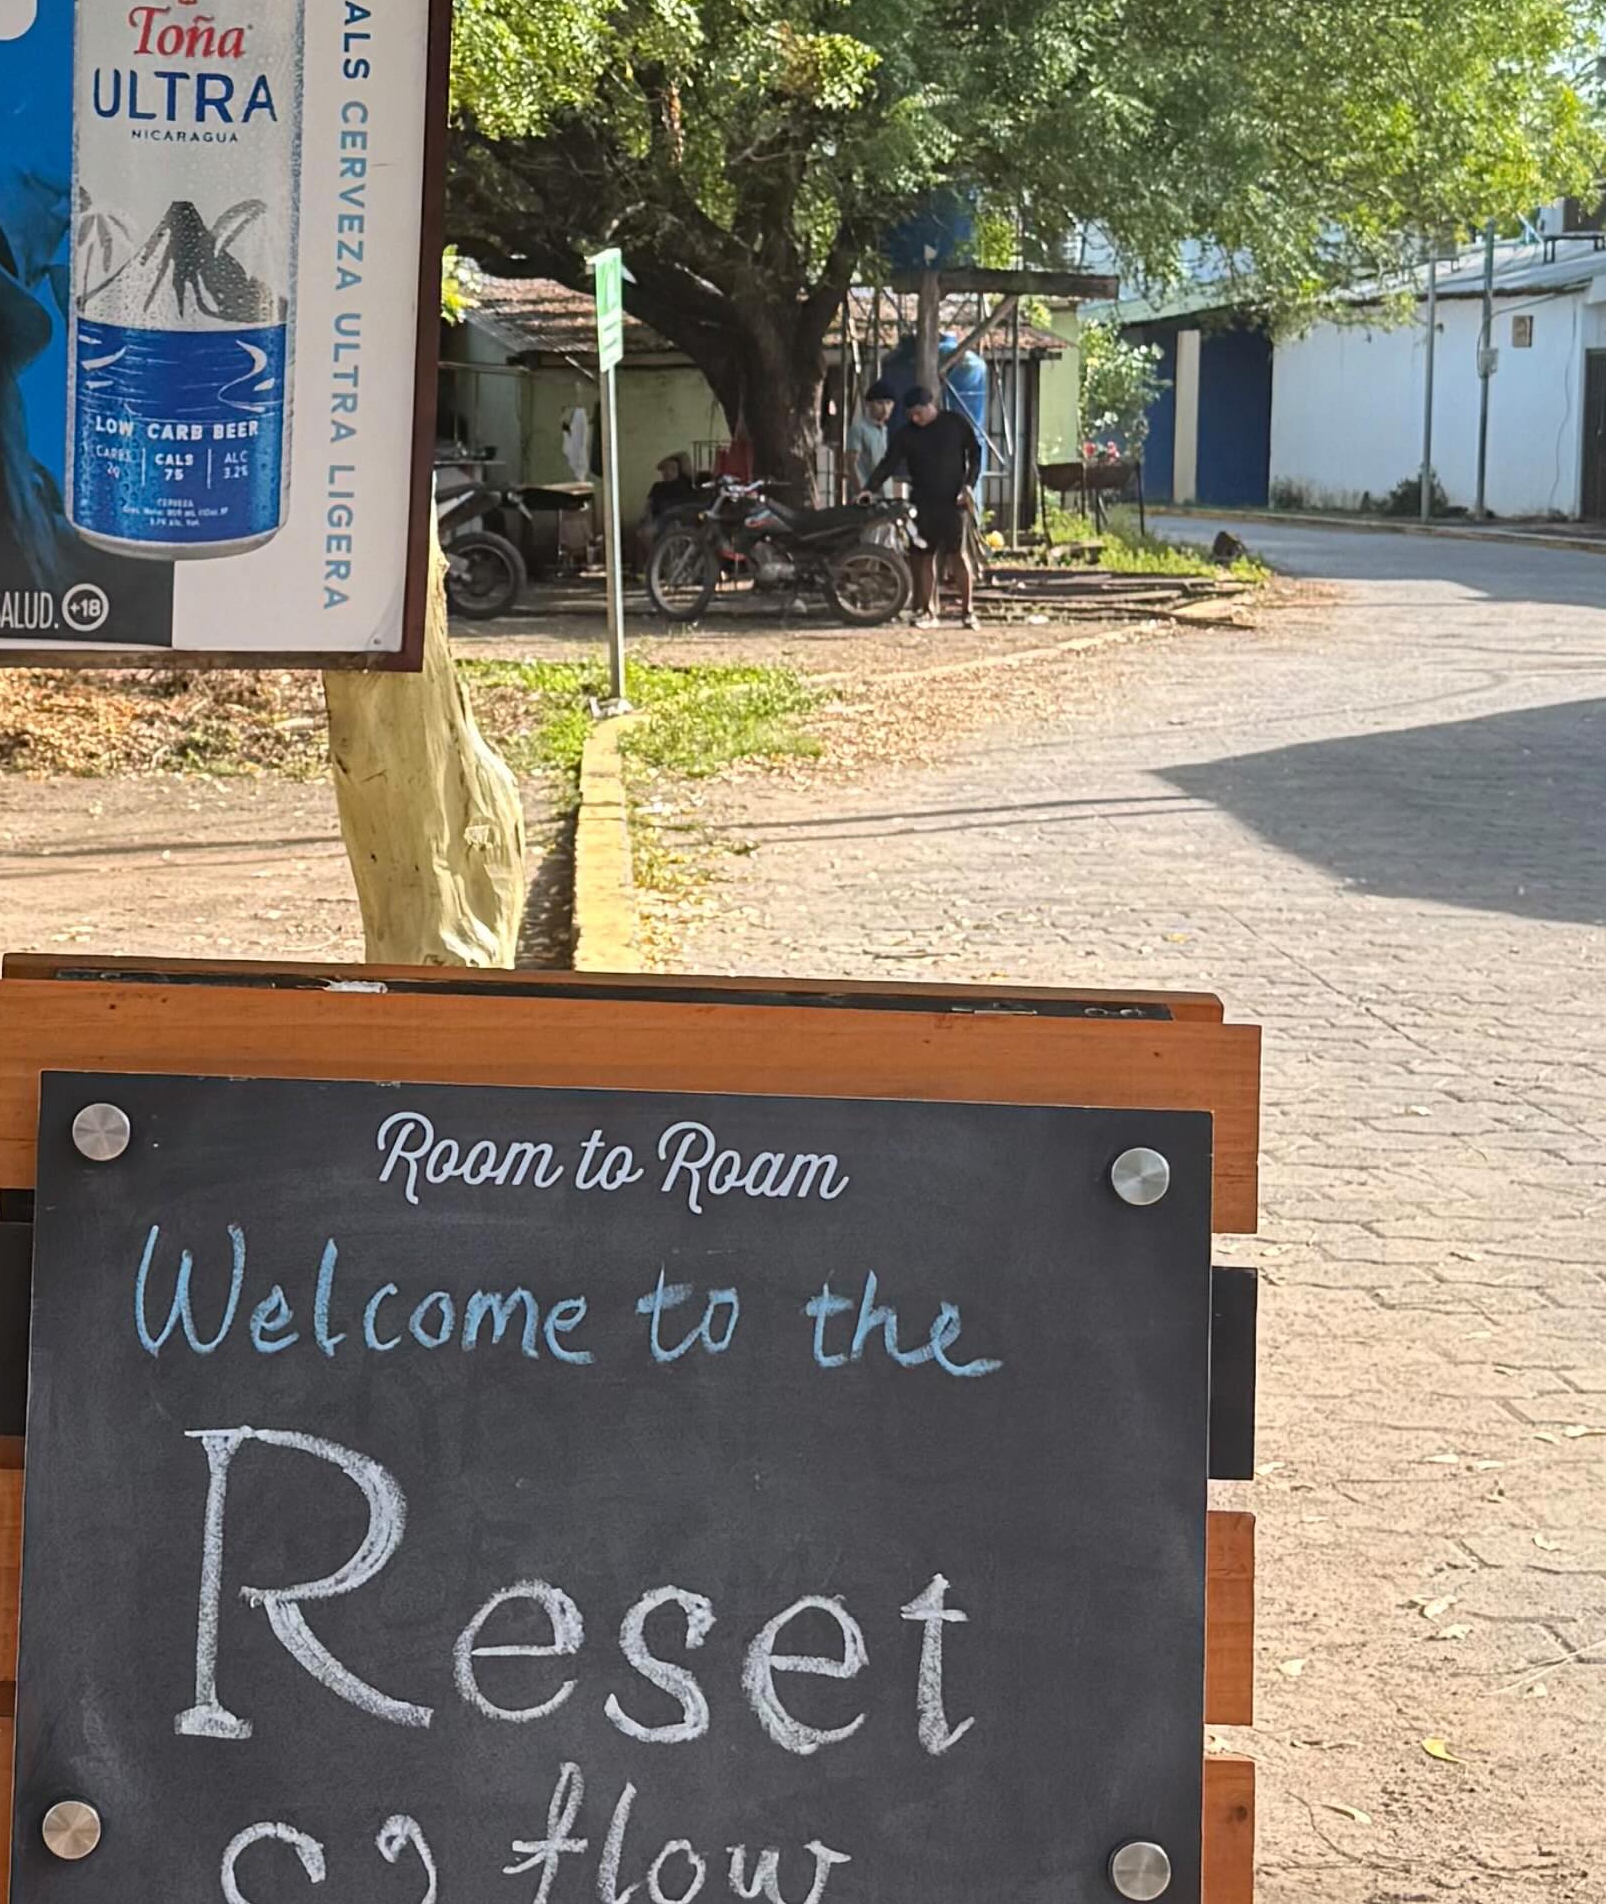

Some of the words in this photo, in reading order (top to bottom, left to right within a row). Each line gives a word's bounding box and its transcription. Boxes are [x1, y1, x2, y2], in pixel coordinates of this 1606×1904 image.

[128, 5, 247, 60] Toña
[93, 67, 278, 124] ULTRA
[131, 129, 239, 144] NICARAGUA
[335, 101, 368, 291] CERVEZA
[330, 311, 361, 445] ULTRA
[95, 415, 134, 438] LOW
[147, 423, 203, 441] CARB
[212, 420, 259, 441] BEER
[154, 453, 194, 466] CALS
[223, 450, 248, 464] ALC
[323, 464, 355, 610] LIGERA
[68, 597, 101, 618] +18
[376, 1111, 564, 1204] Room
[575, 1121, 643, 1192] to
[657, 1118, 850, 1214] Roam
[135, 1222, 594, 1365] Welcome
[637, 1263, 742, 1362] to
[804, 1270, 1002, 1378] the
[173, 1424, 974, 1758] Reset
